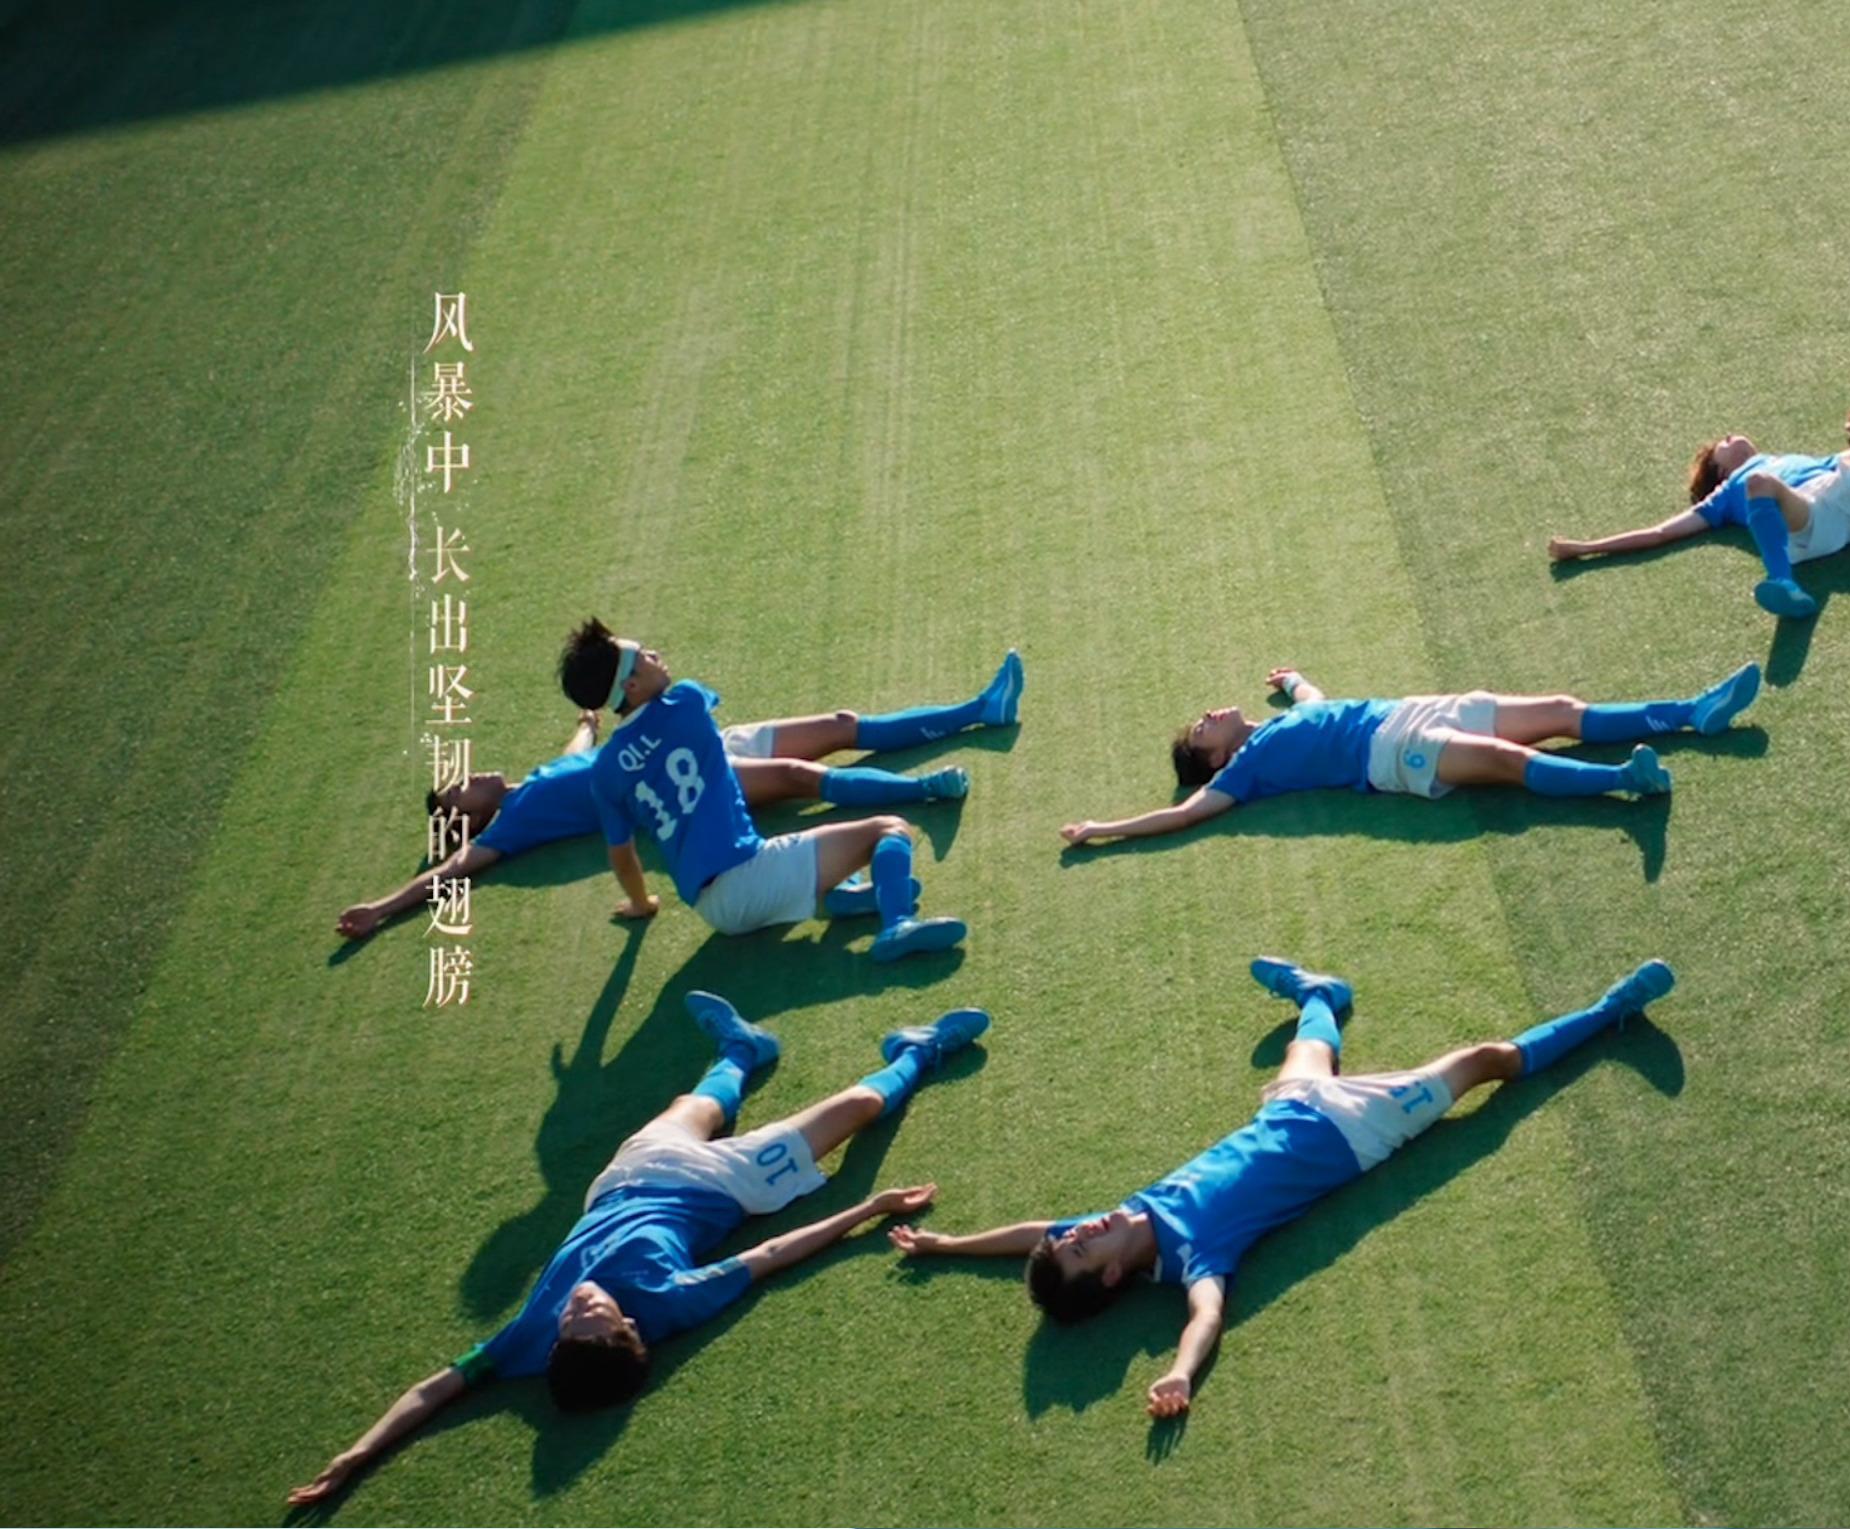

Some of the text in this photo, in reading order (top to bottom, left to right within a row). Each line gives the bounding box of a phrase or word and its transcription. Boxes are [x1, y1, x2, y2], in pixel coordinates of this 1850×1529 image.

[618, 734, 662, 771] QI.L
[635, 747, 705, 841] 18
[757, 1143, 798, 1186] 10
